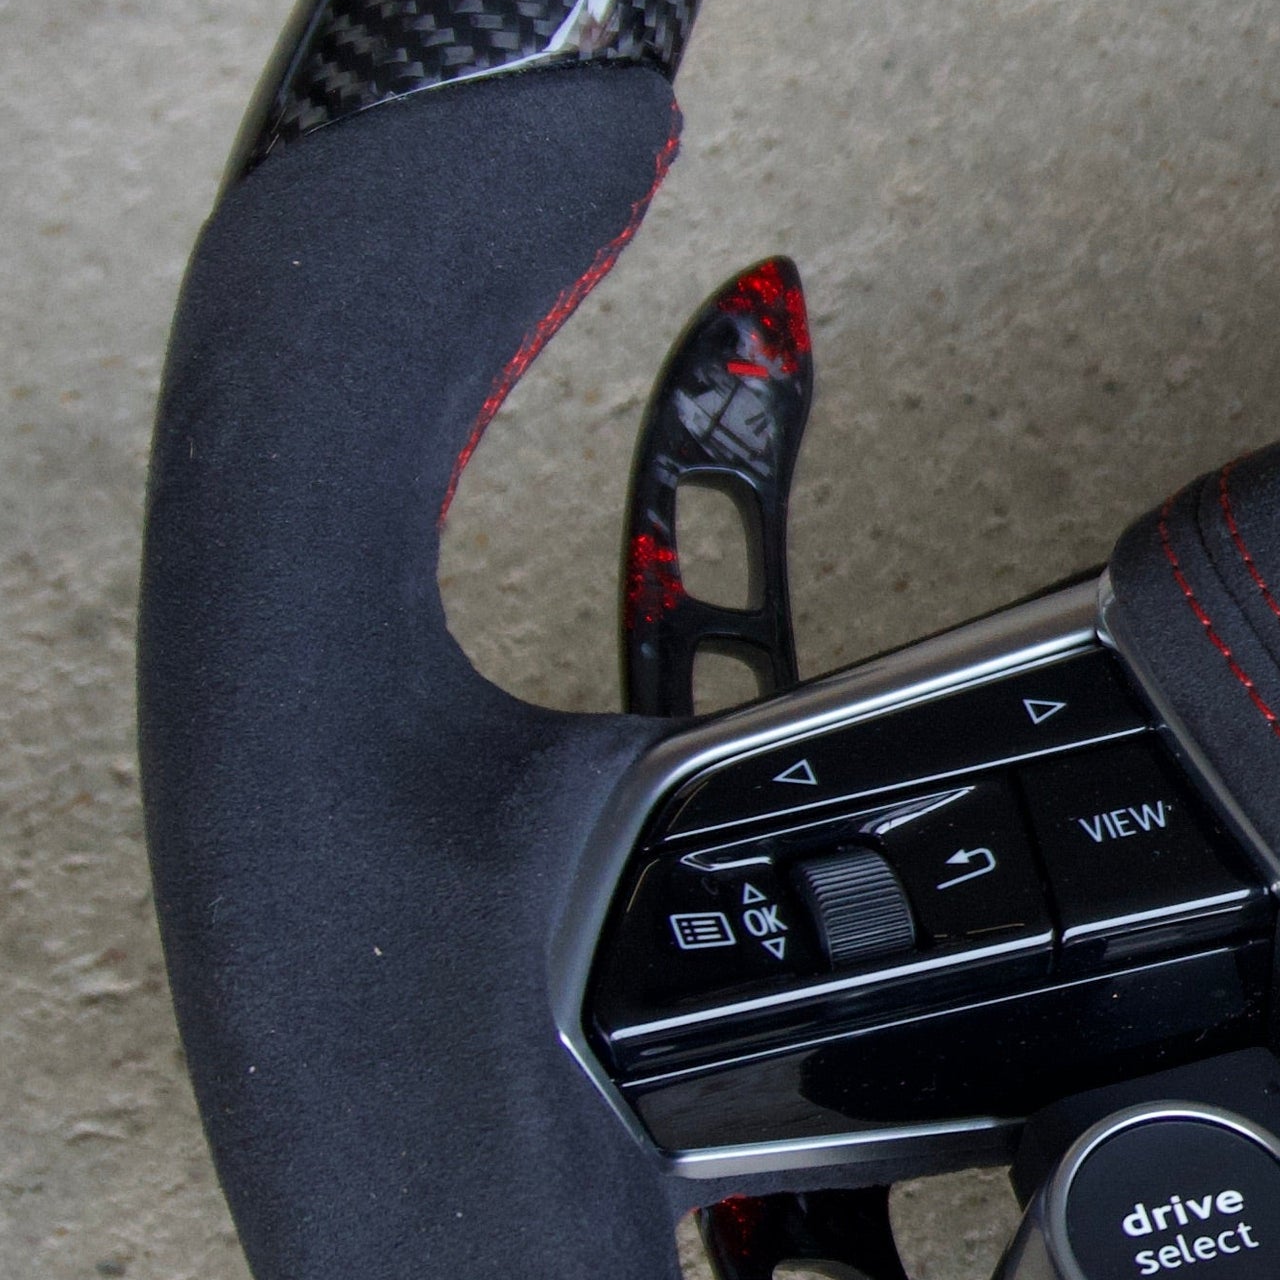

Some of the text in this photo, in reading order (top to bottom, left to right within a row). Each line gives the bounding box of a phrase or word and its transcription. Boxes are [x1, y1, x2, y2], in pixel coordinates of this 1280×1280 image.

[1078, 800, 1167, 842] VIEW
[743, 905, 788, 937] OK
[1122, 1189, 1244, 1237] drive
[1134, 1222, 1260, 1275] select
